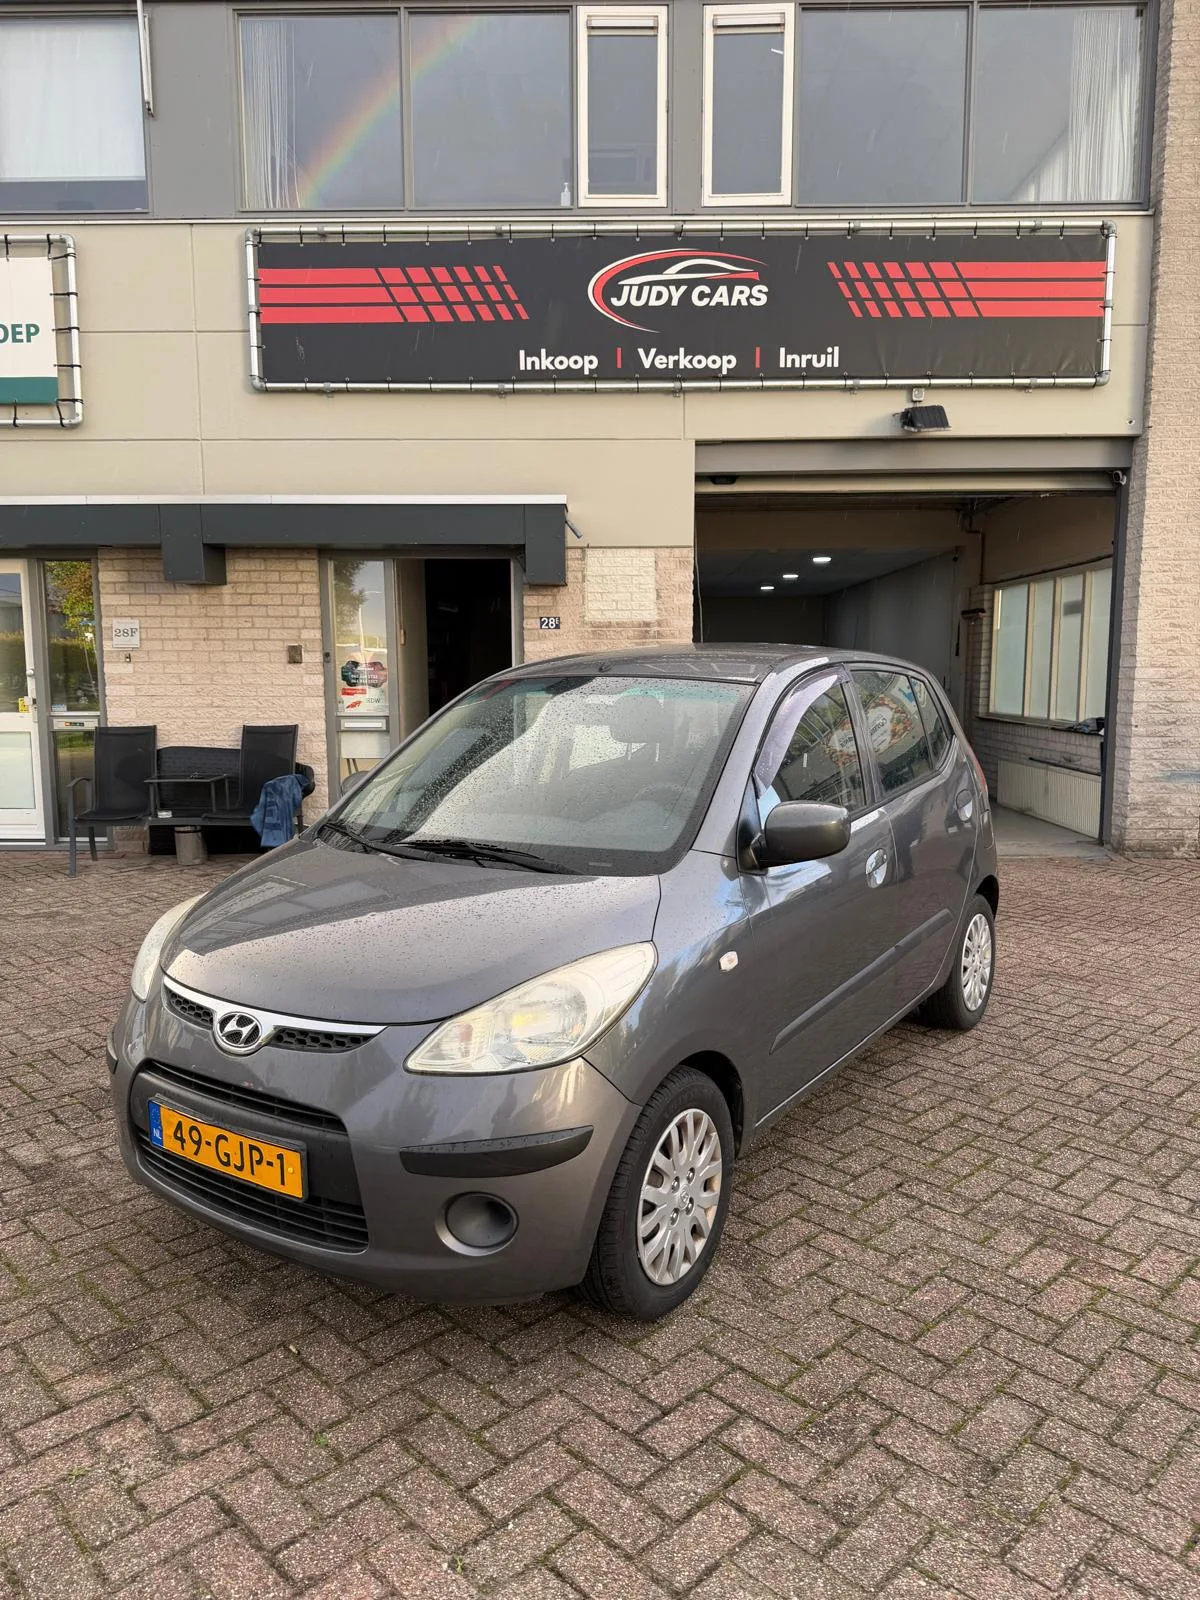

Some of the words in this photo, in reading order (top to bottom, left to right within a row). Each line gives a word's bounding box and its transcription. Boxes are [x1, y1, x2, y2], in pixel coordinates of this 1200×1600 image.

[610, 285, 688, 307] JUDY
[691, 284, 769, 307] CARS
[519, 348, 599, 375] Inkoop
[637, 347, 737, 375] Verkoop
[779, 346, 840, 368] Inruil
[114, 627, 138, 638] 28F
[153, 1127, 162, 1140] NL
[173, 1120, 286, 1186] 49-GJP-1
